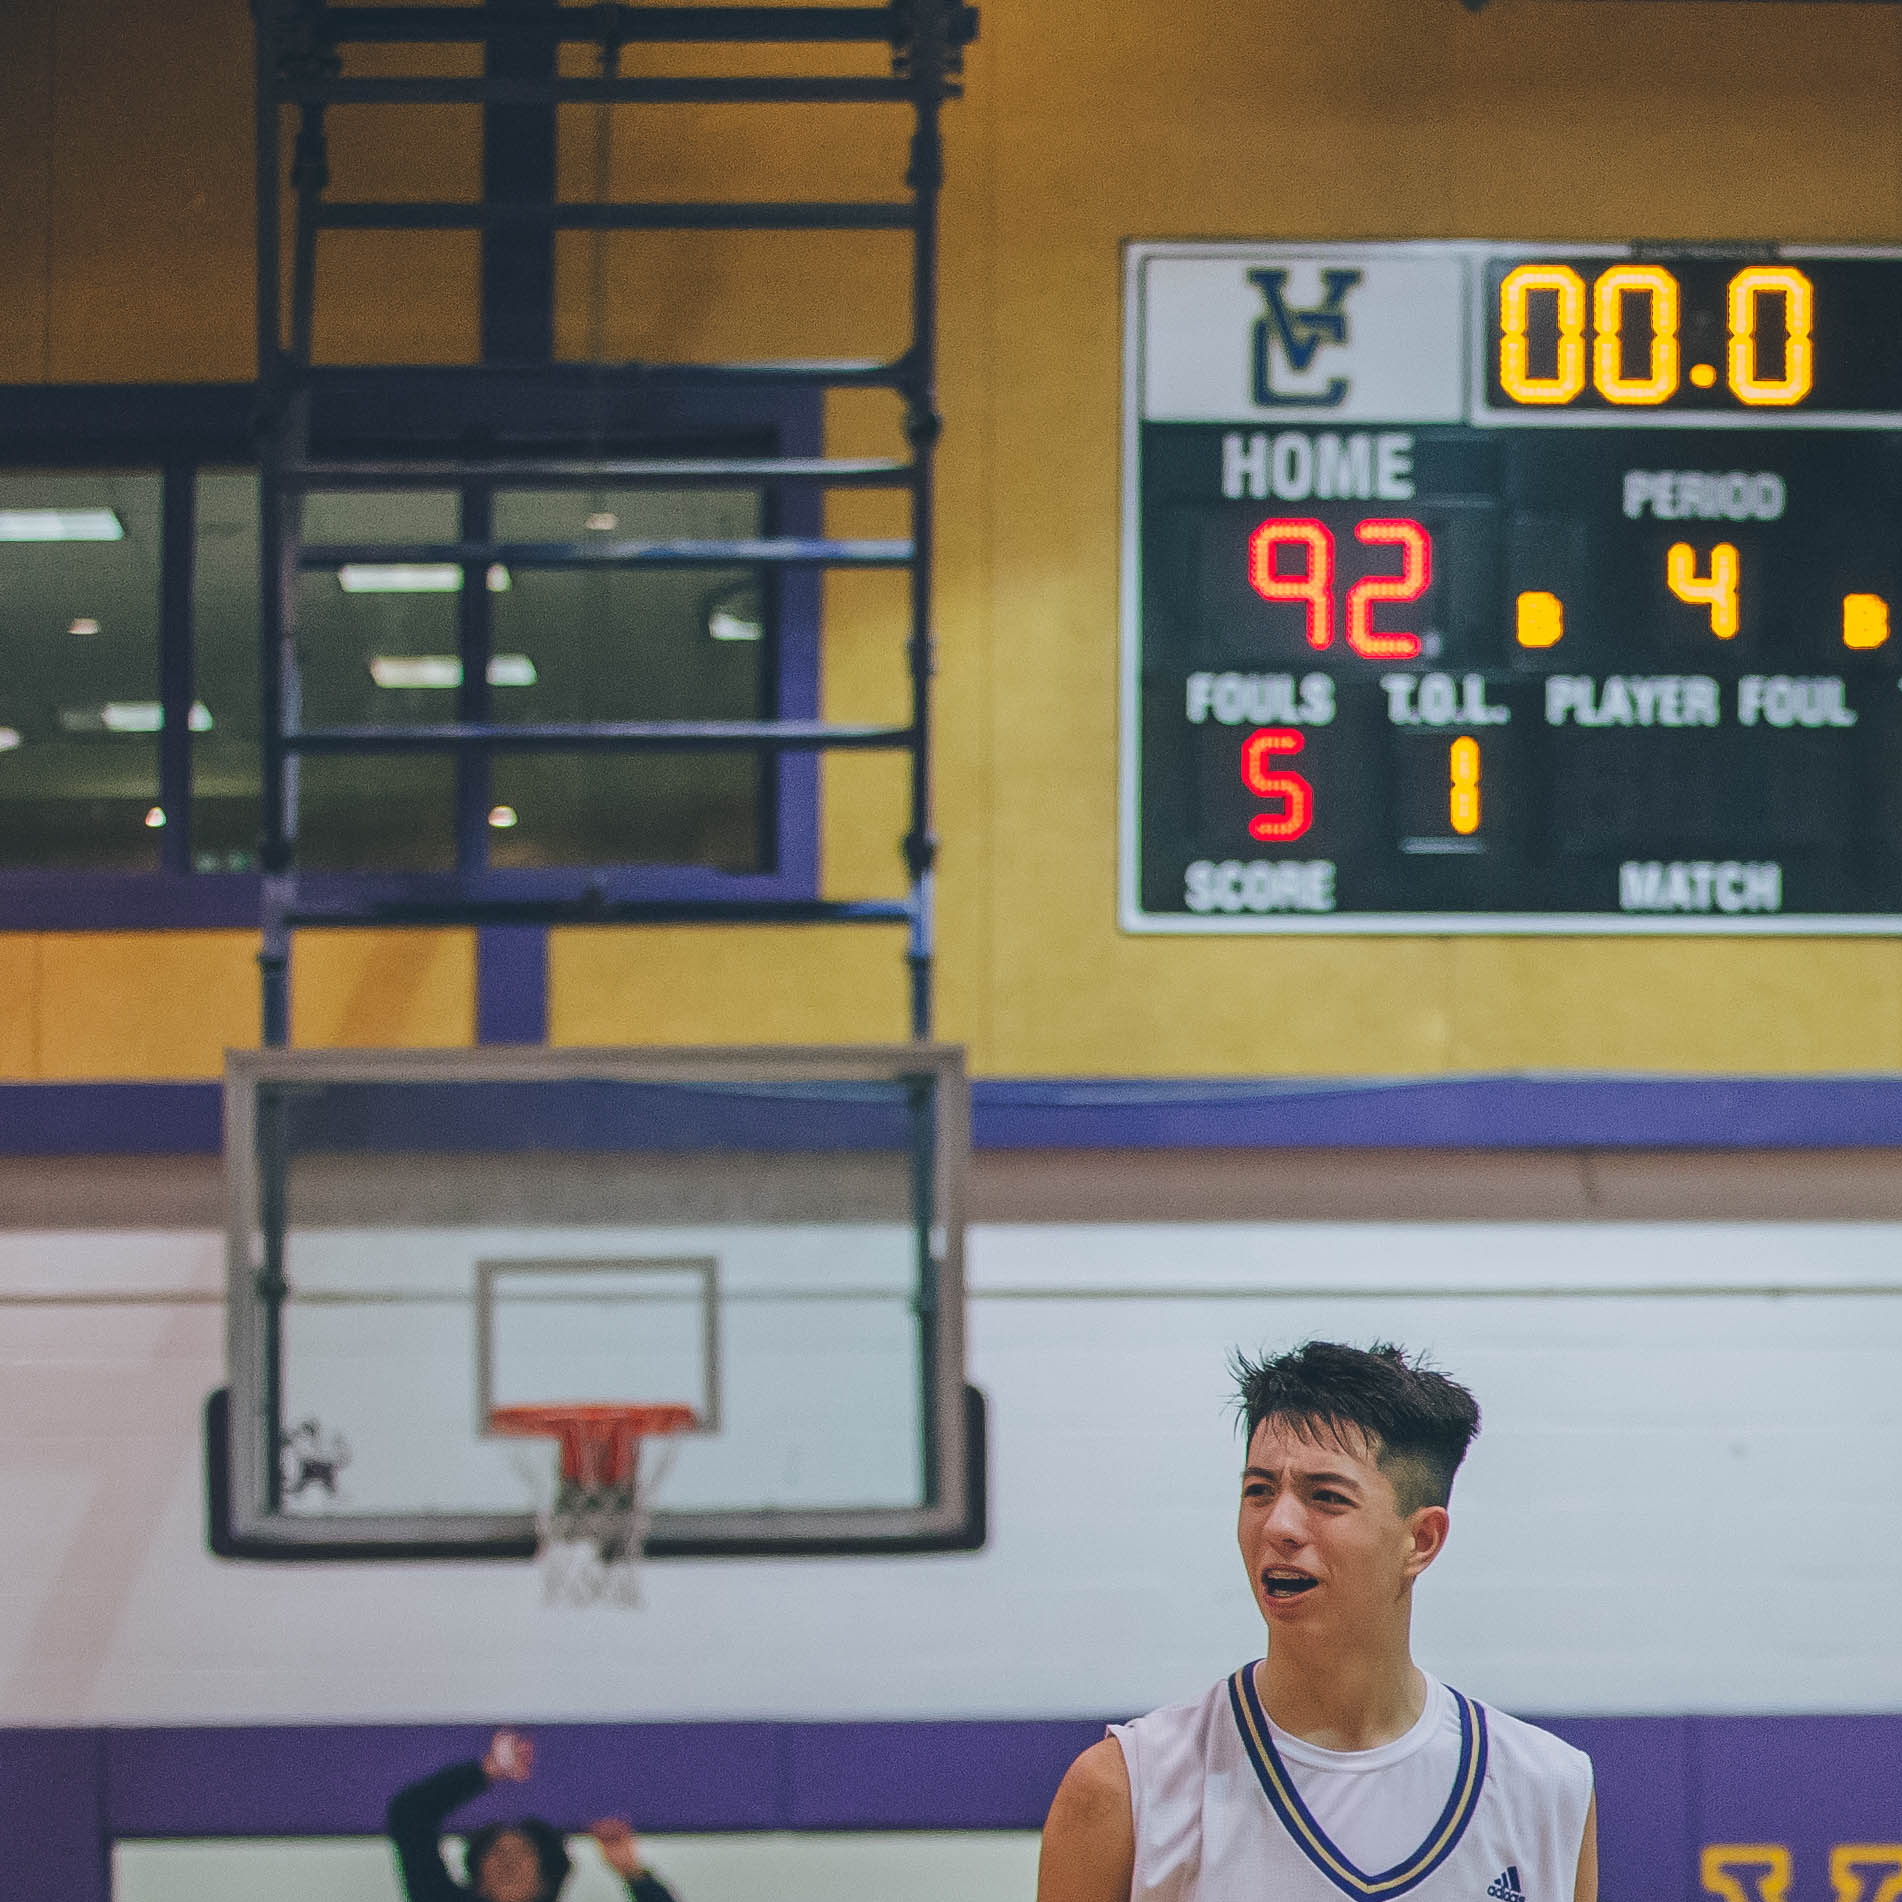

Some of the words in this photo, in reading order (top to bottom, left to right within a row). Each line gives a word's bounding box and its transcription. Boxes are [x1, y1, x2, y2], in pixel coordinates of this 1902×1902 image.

[1500, 265, 1813, 405] 00.0
[1221, 432, 1415, 500] HOME
[1623, 468, 1786, 521] PERIOD
[1248, 518, 1432, 659] 92
[1667, 542, 1739, 639] 4
[1186, 672, 1336, 726] FOULS
[1380, 672, 1511, 726] T.O.L.
[1545, 674, 1719, 727] PLAYER
[1738, 674, 1858, 727] FOUL
[1241, 727, 1313, 842] 5
[1449, 735, 1480, 835] 1
[1184, 859, 1336, 912] SCORE
[1619, 861, 1783, 912] MATCH
